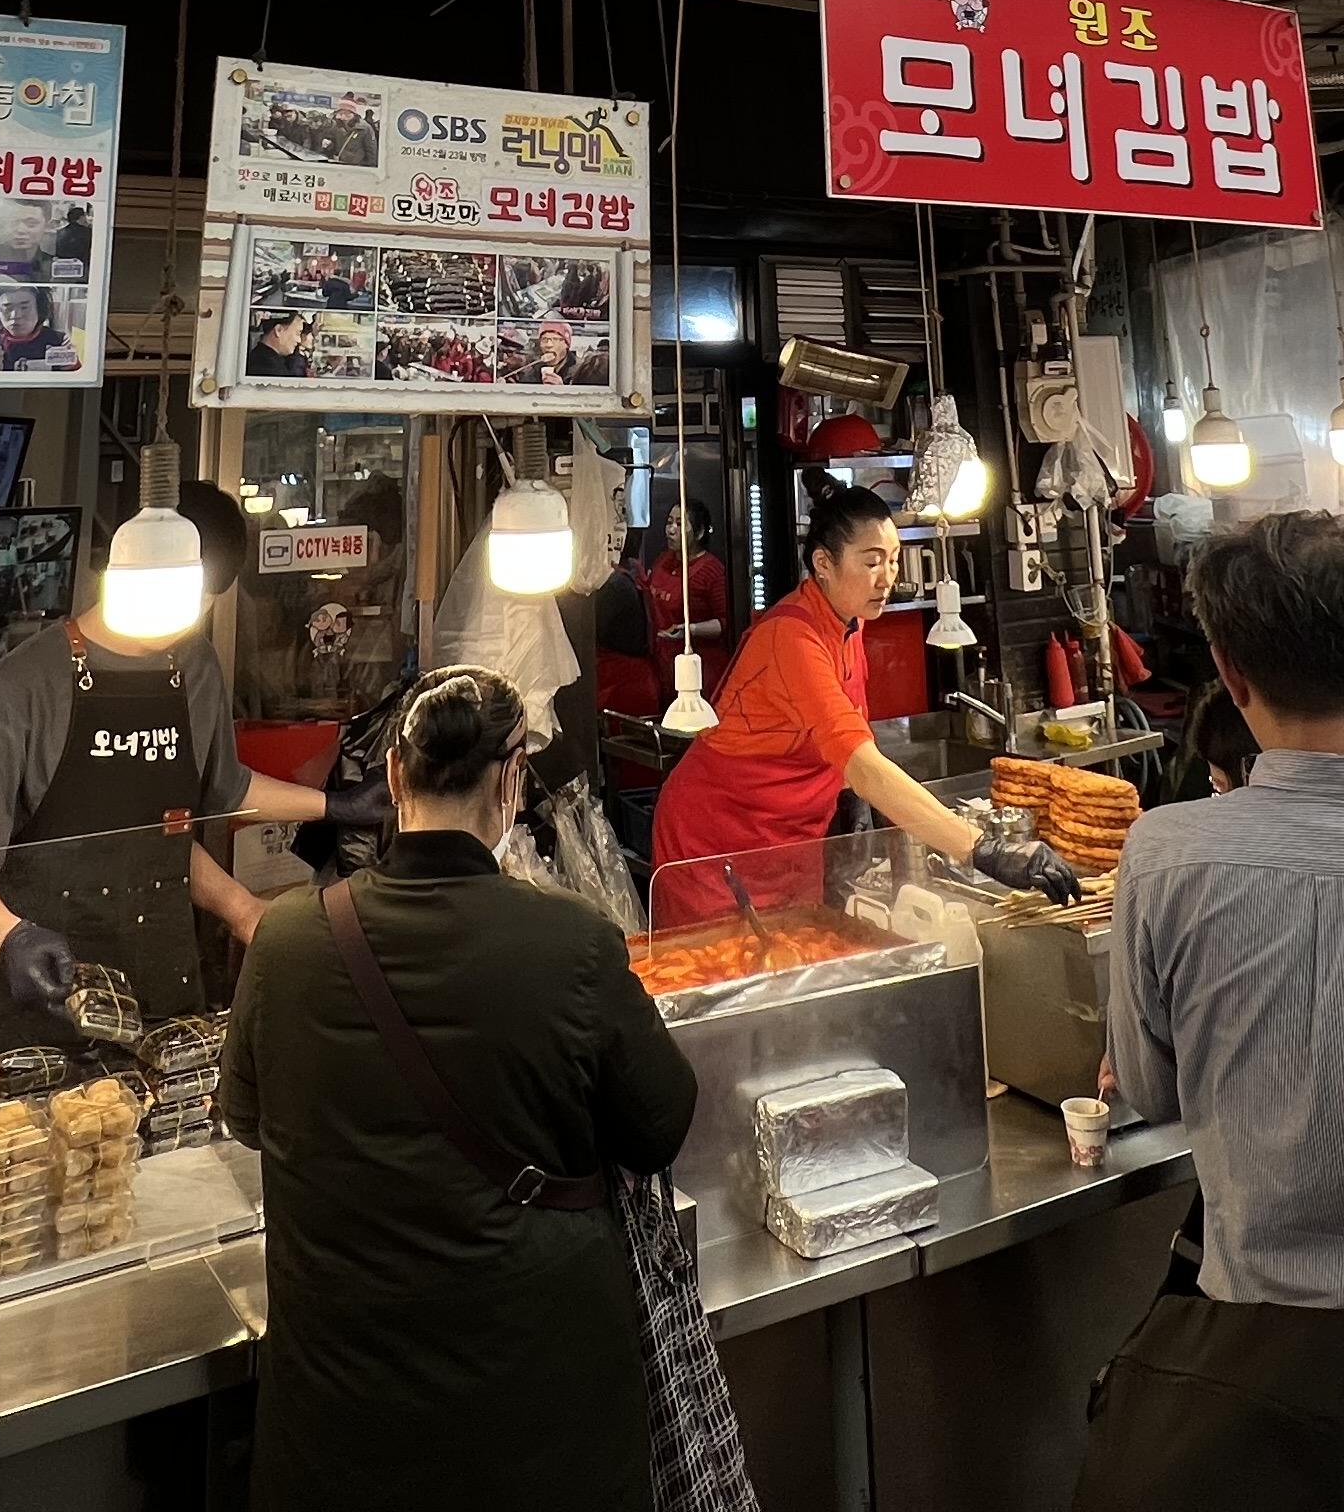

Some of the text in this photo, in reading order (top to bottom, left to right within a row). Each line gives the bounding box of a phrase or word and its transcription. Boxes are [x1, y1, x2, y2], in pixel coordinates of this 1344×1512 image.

[431, 114, 487, 144] SBS
[879, 35, 1281, 194] 모녀김밥
[401, 146, 431, 158] 2014년
[502, 126, 601, 175] 런닝맨
[487, 187, 635, 232] 모녀김밥
